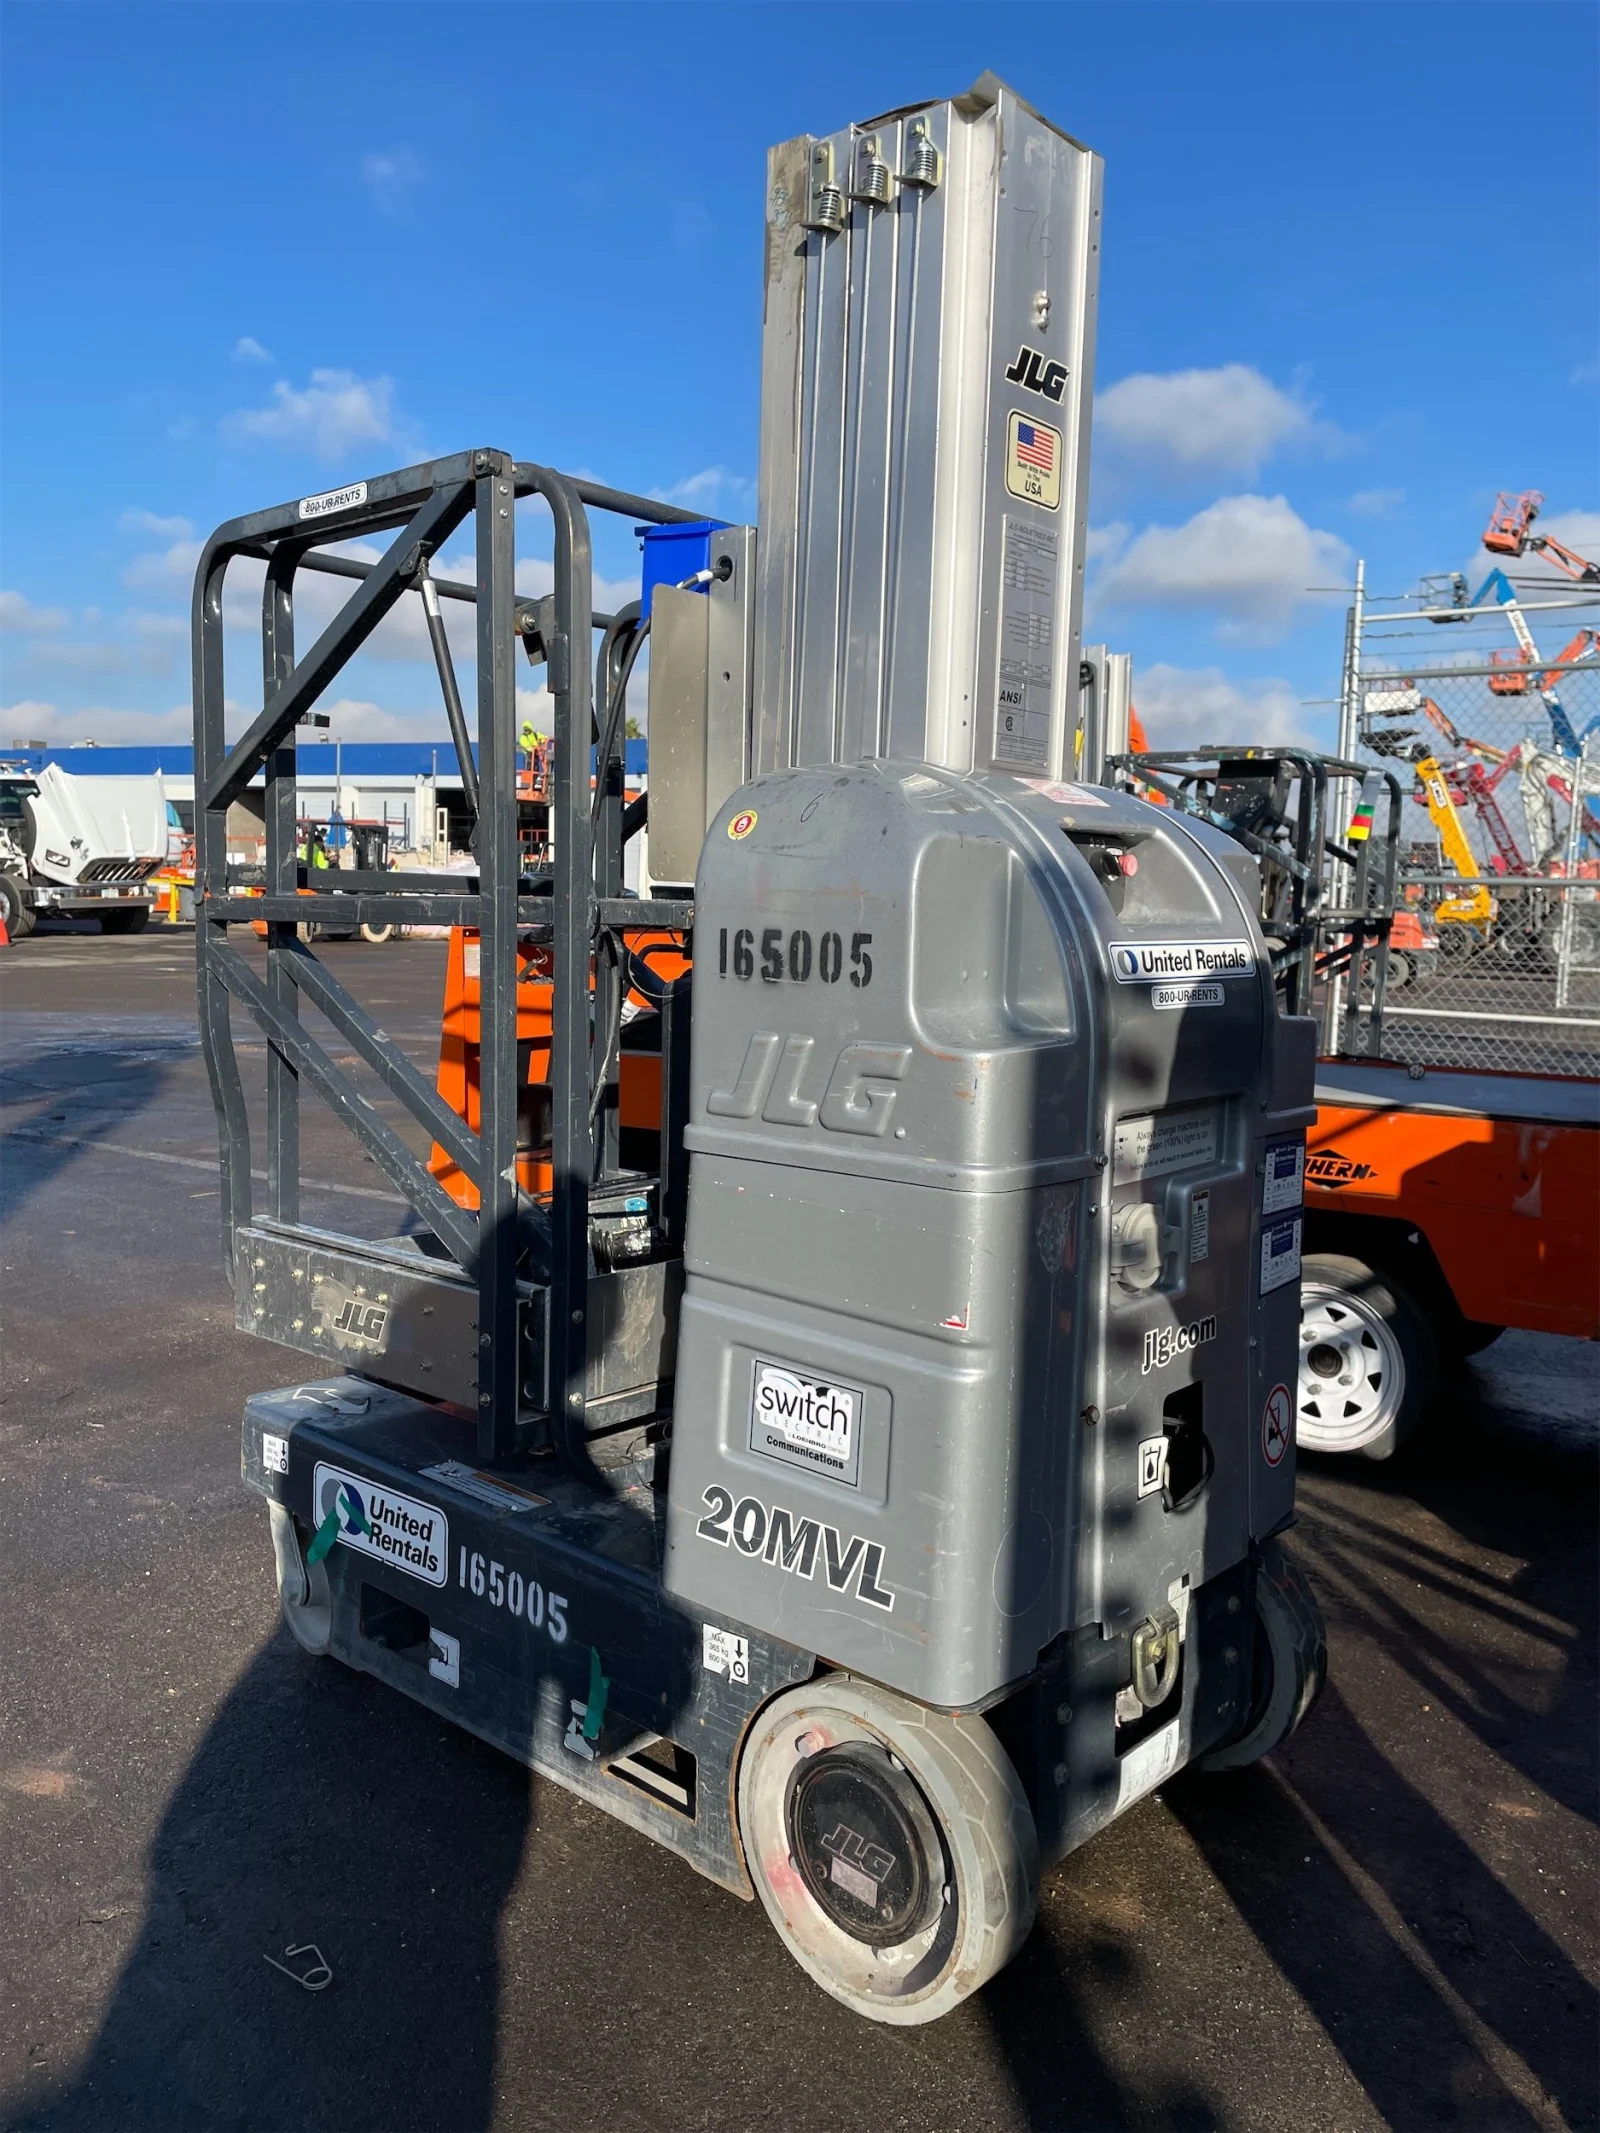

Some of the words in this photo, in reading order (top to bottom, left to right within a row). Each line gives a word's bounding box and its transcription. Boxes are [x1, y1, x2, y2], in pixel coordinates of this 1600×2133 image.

[1005, 345, 1070, 403] JLG
[1025, 480, 1042, 497] USA
[1039, 469, 1051, 480] Pride
[1018, 525, 1046, 541] INDUSTRIES
[1000, 689, 1022, 705] ANSI
[719, 927, 873, 988] 165005
[1141, 949, 1193, 973] United
[1195, 947, 1246, 970] Rentals
[1159, 988, 1218, 1003] 800-UR-RENTS
[706, 1030, 914, 1137] JLG
[1136, 1130, 1157, 1141] Always
[1157, 1126, 1177, 1137] charge
[1177, 1120, 1199, 1132] machine
[1136, 1144, 1146, 1154] the
[1147, 1142, 1163, 1154] green
[1164, 1136, 1184, 1149] (100%)
[1306, 1159, 1372, 1179] HERN
[332, 1300, 388, 1342] JLG
[1143, 1316, 1217, 1373] jlg.com
[760, 1386, 848, 1436] switch
[763, 1412, 844, 1446] ELECTRIC
[766, 1434, 844, 1470] Communications
[370, 1495, 434, 1543] United
[369, 1521, 439, 1573] Rentals
[697, 1484, 895, 1612] 20MVL
[459, 1545, 569, 1643] 165005
[711, 1632, 726, 1645] MAX
[721, 1647, 729, 1658] kg
[820, 1823, 897, 1883] JLG
